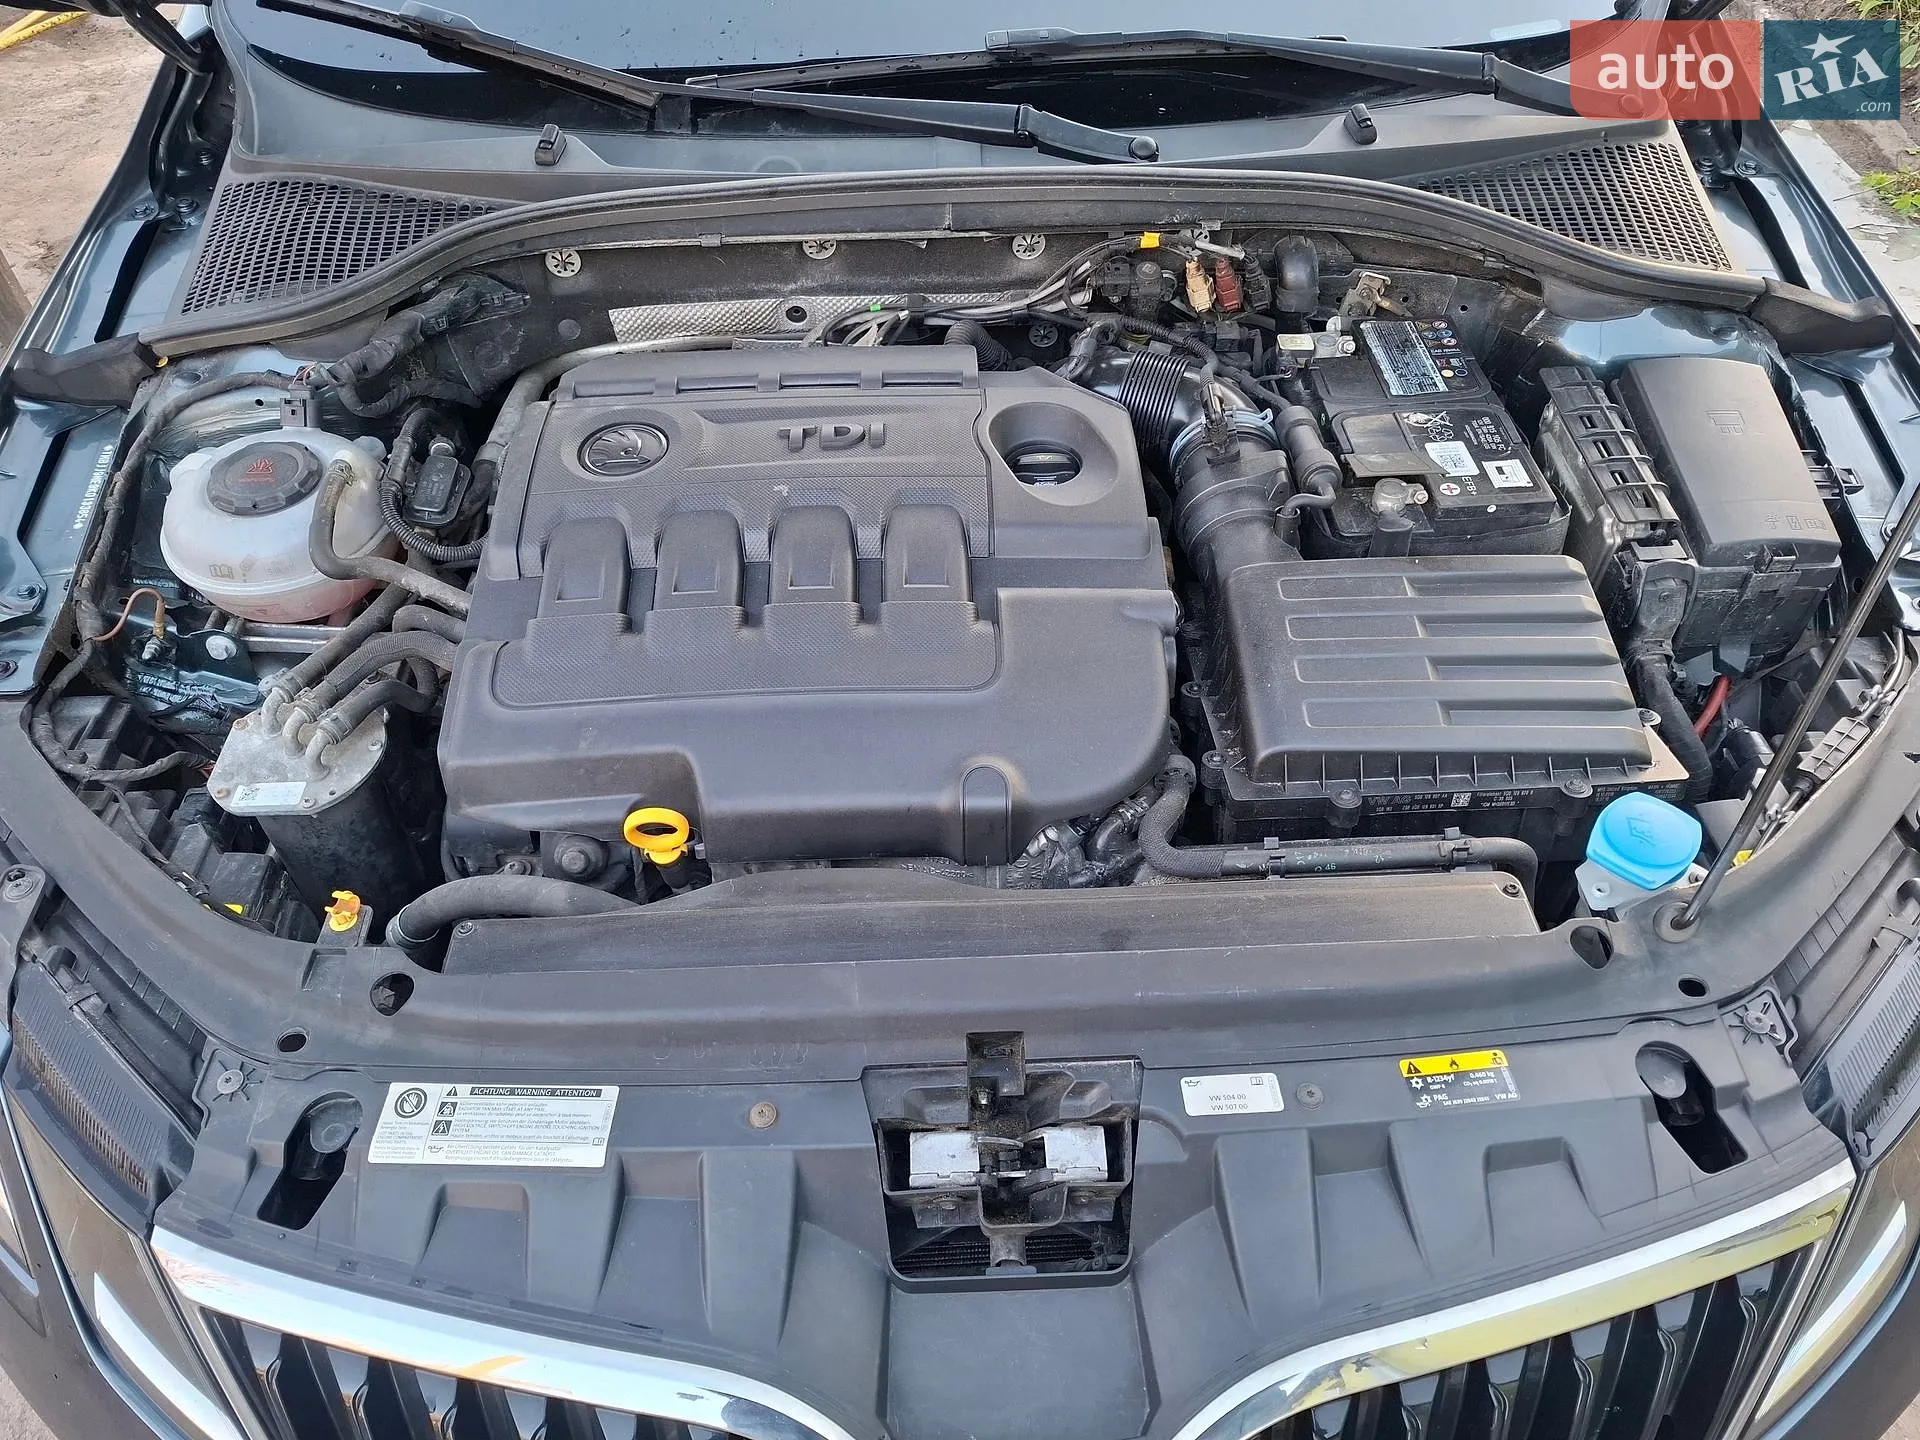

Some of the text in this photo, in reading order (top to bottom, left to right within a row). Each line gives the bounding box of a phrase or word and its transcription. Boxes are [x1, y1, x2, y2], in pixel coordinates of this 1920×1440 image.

[777, 422, 886, 453] TDI
[1462, 476, 1477, 496] EFB+
[1426, 1074, 1455, 1084] R-1234yf
[472, 1088, 597, 1097] ACHTUNG WARNING ATTENTION
[1433, 1093, 1449, 1101] PAG
